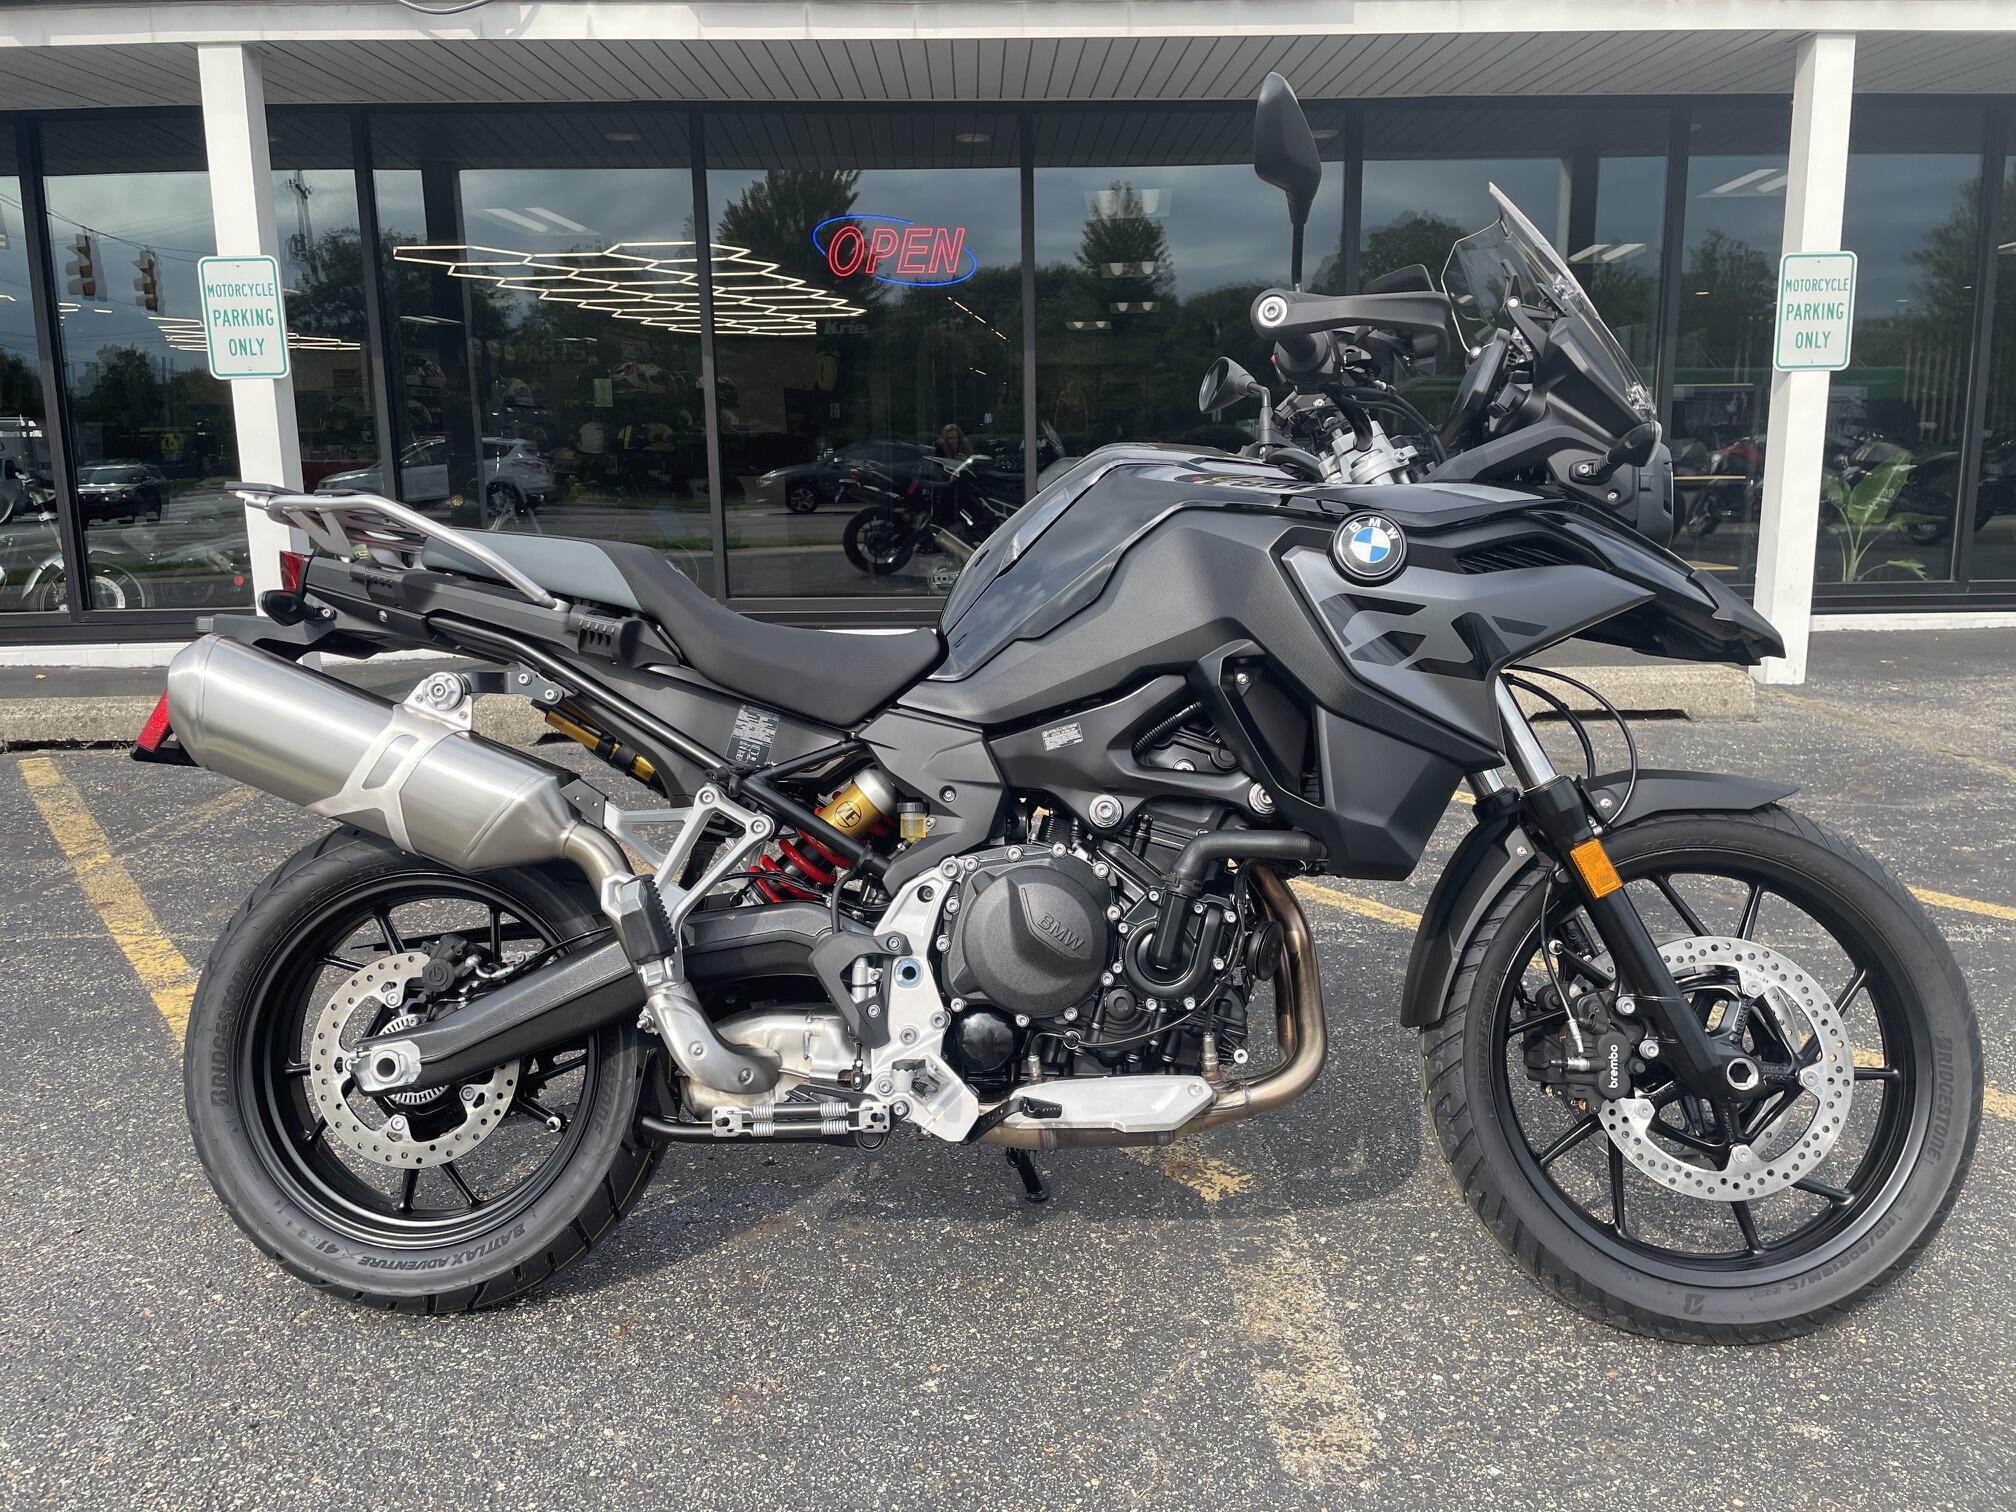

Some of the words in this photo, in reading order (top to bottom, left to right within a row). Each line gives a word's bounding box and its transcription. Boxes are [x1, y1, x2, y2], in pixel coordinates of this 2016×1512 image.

[829, 225, 965, 277] OPEN
[207, 283, 275, 297] MOTORCYCLE
[1785, 278, 1849, 292] MOTORCYCLE
[213, 308, 274, 327] PARKING
[1786, 303, 1844, 320] PARKING
[229, 338, 264, 356] ONLY
[1795, 331, 1831, 349] ONLY
[1349, 517, 1398, 540] BMW
[1037, 912, 1085, 951] BMW
[1608, 1044, 1619, 1089] brembo
[1931, 1031, 1954, 1162] BRIDGESTONE
[359, 1255, 450, 1271] ADVENTURE
